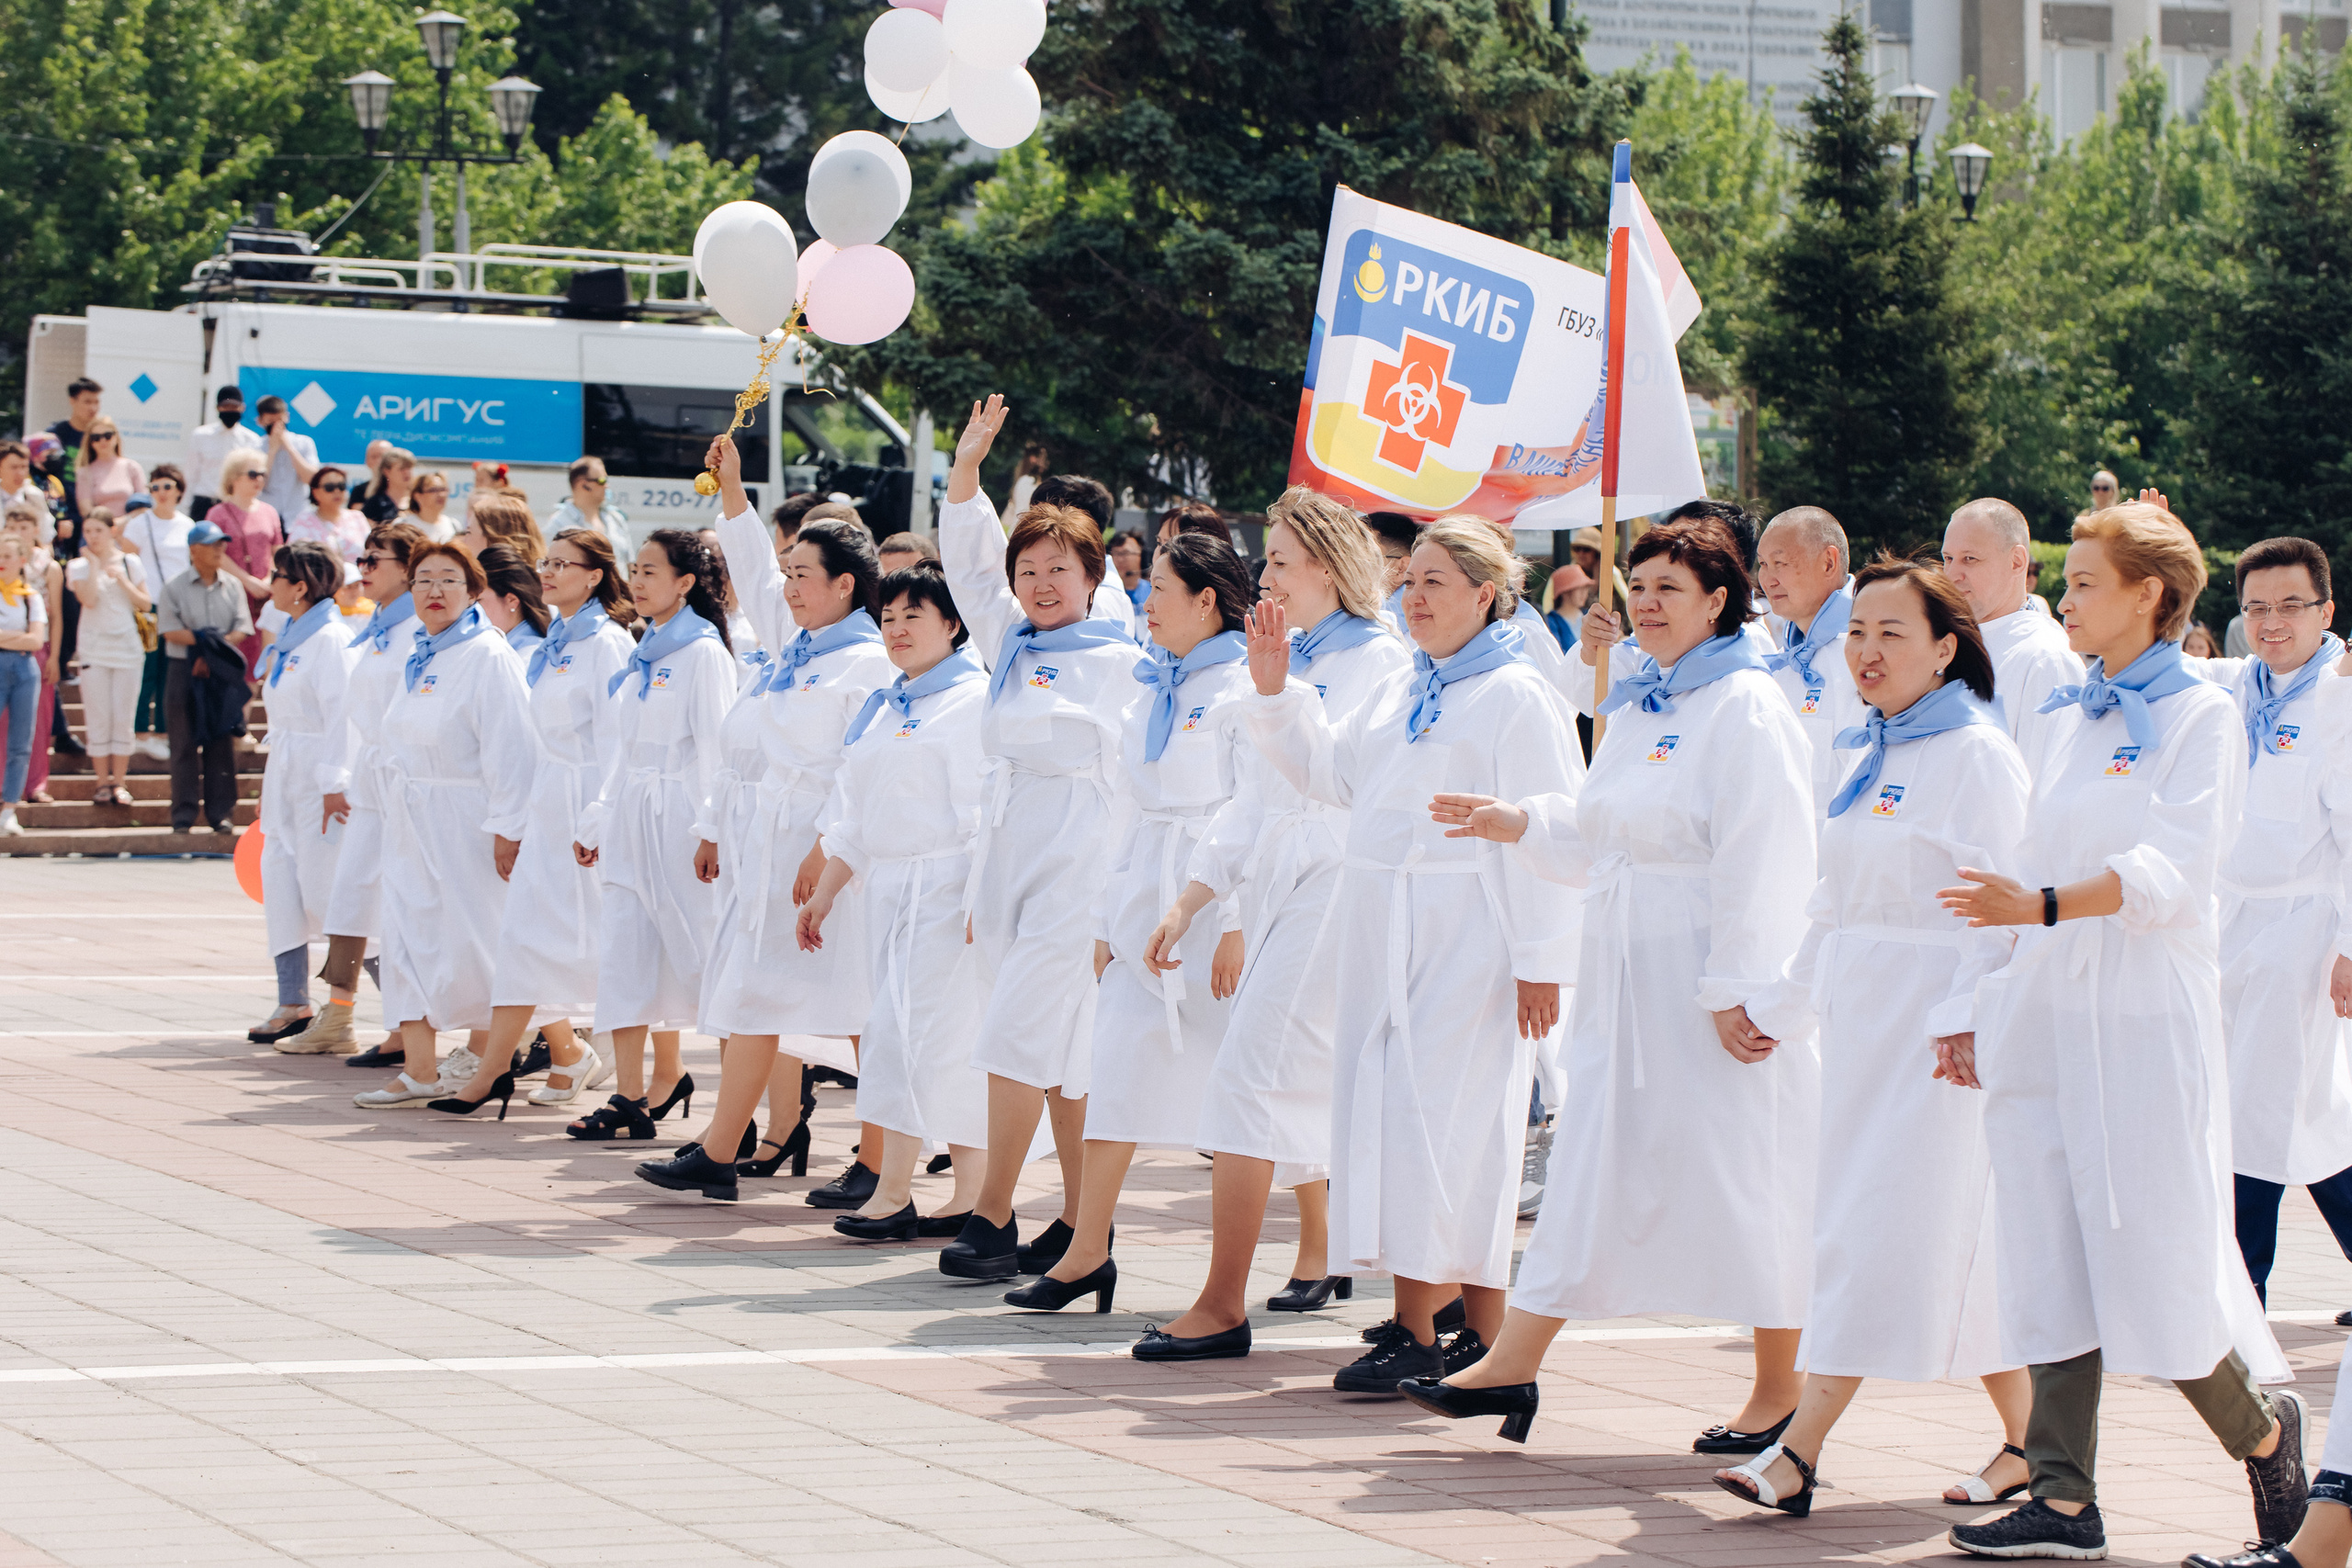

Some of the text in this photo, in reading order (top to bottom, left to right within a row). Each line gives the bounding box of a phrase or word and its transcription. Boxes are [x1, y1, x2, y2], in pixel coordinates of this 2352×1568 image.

[1393, 260, 1520, 343] РКИБ
[1557, 306, 1597, 338] ГБУЗ
[353, 394, 505, 426] АРИГУС
